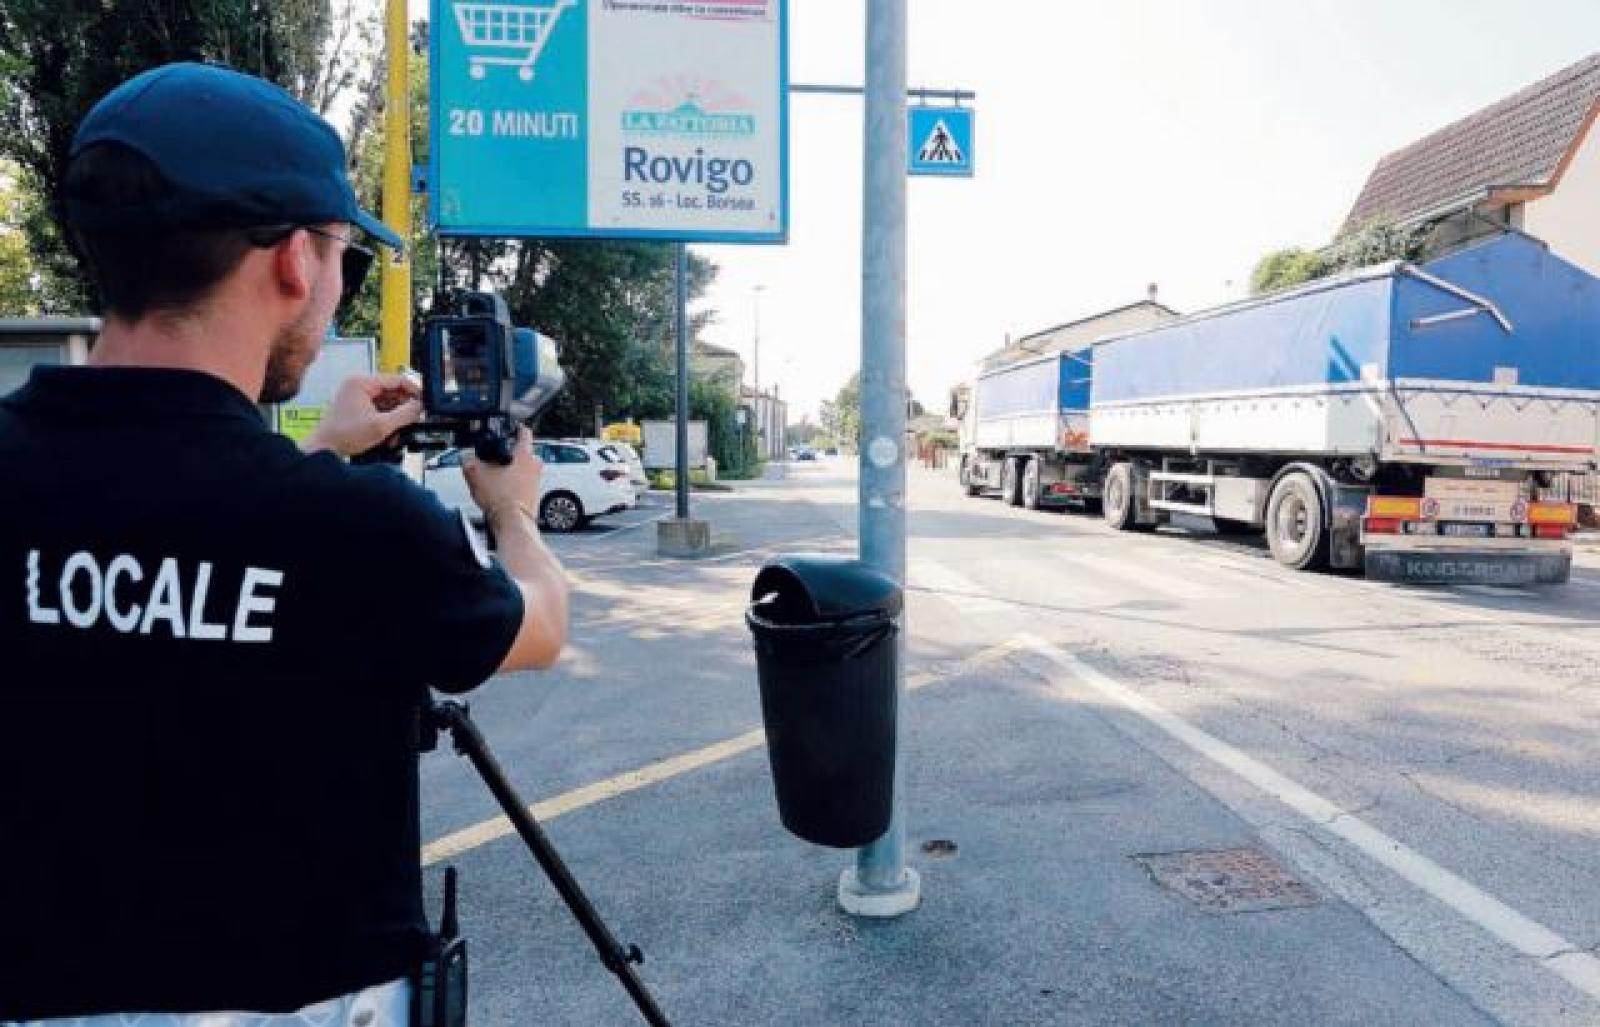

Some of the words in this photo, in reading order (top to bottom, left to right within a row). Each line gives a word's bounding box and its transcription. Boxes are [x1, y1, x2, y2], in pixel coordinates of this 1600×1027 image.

[449, 109, 483, 136] 20
[492, 110, 578, 138] MINUTI
[623, 146, 754, 193] Rovigo
[26, 548, 285, 643] LOCALE
